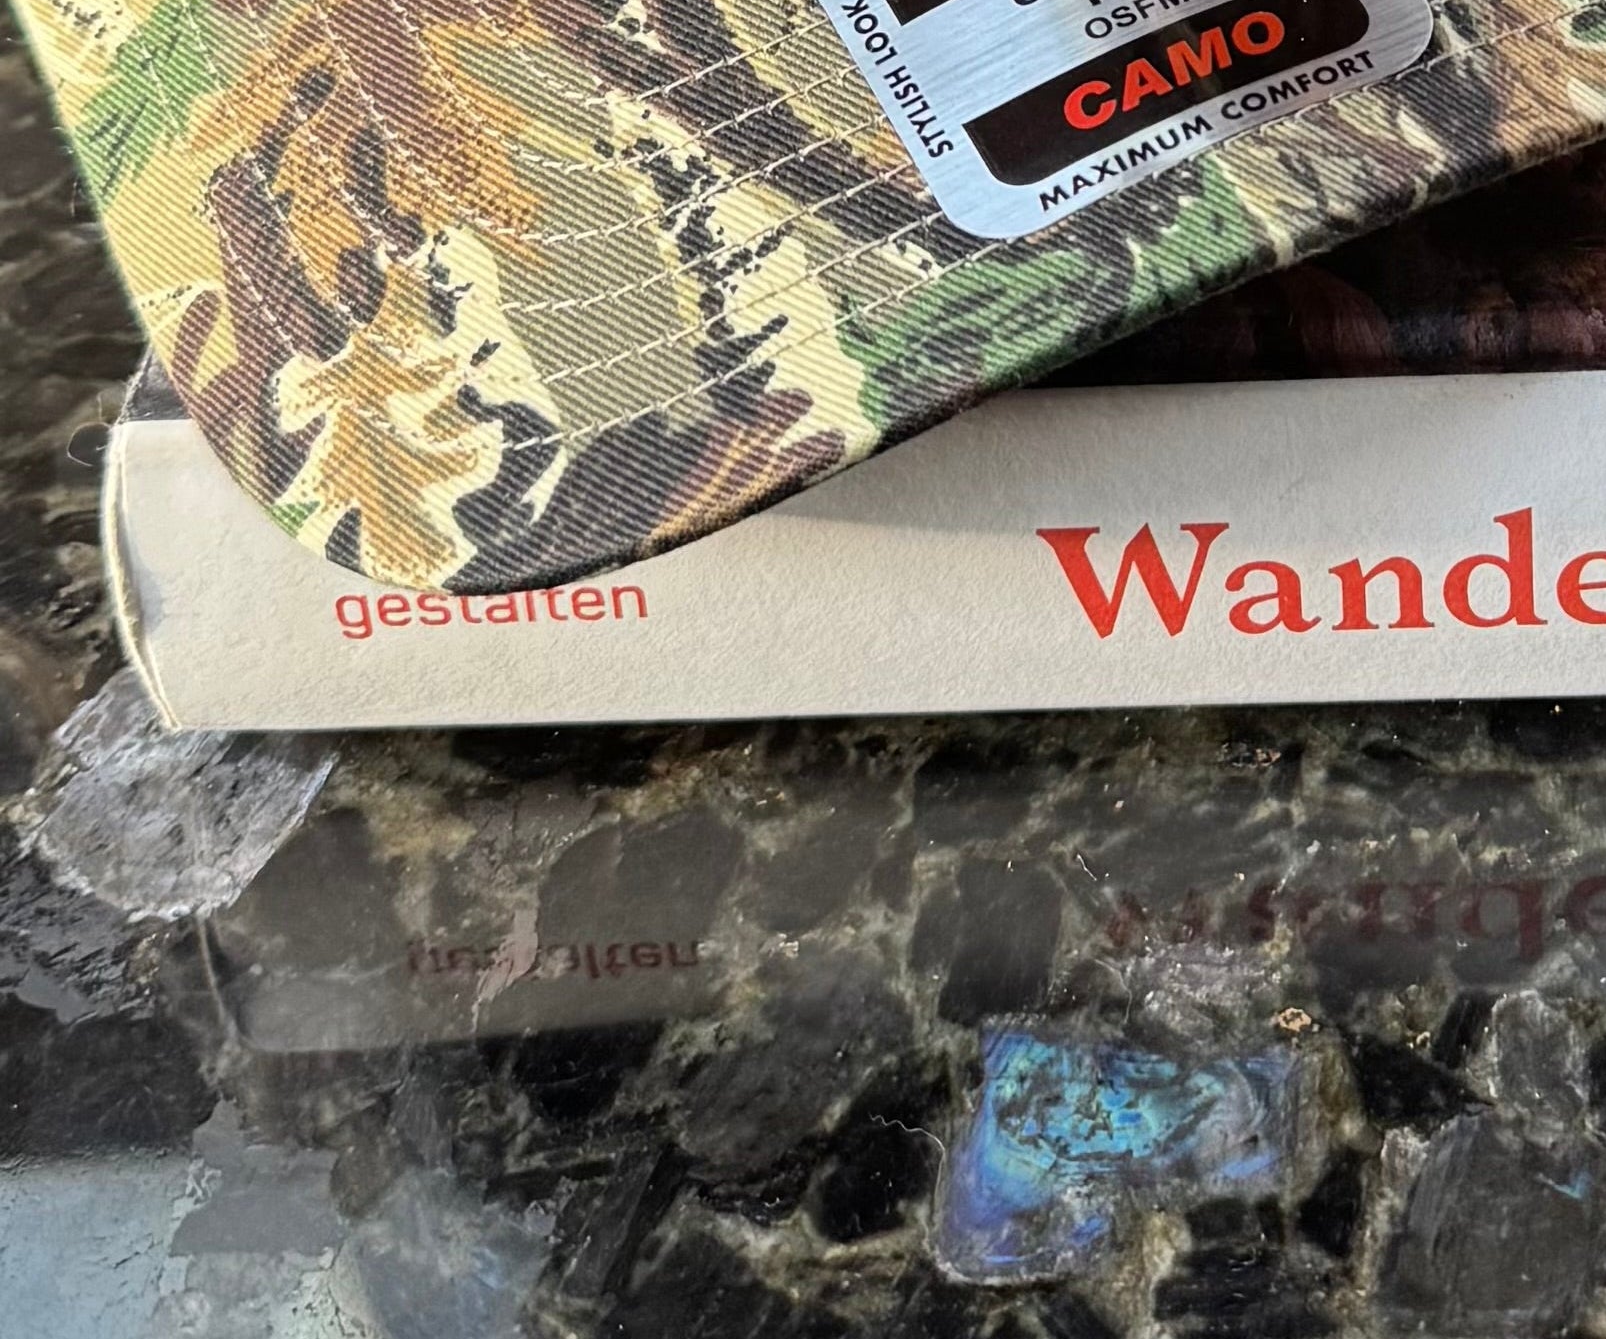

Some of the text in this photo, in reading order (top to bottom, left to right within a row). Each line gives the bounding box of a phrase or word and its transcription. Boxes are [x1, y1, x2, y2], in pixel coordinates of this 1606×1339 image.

[883, 65, 954, 158] STYLISH
[1062, 10, 1286, 132] CAMO
[1040, 49, 1377, 213] MAXIMUM COMFORT
[334, 585, 649, 640] gestalten
